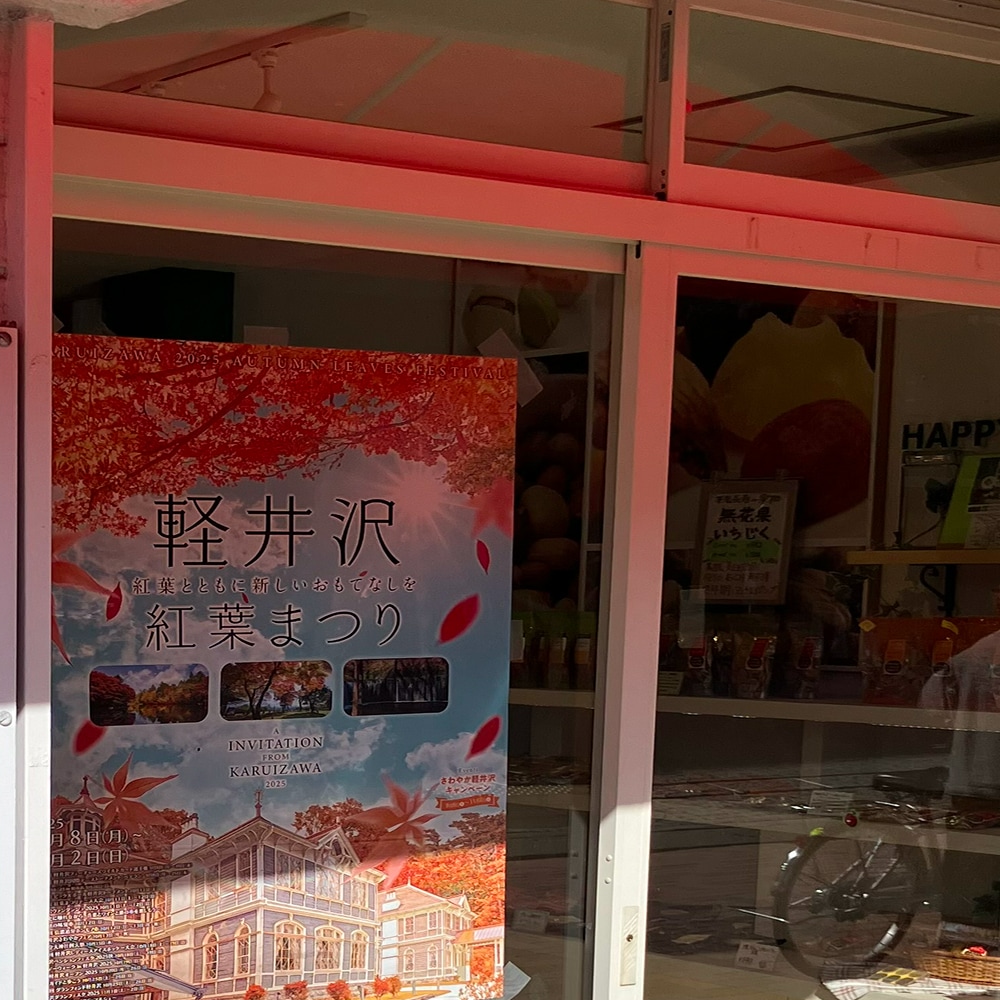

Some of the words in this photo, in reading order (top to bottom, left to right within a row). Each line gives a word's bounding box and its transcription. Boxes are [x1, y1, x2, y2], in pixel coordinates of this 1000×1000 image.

[175, 352, 220, 366] 2025
[233, 357, 321, 371] AUTUMN
[333, 360, 405, 375] LEAVES
[416, 364, 506, 380] FESTIVAL
[902, 418, 1000, 450] HAPP
[153, 494, 401, 569] 軽井沢
[713, 526, 770, 541] いちじく
[132, 575, 418, 595] 紅葉とともに新しいおもてなしを
[145, 602, 403, 652] 紅葉まつり
[228, 737, 324, 751] INVITATION
[262, 753, 290, 762] FROM
[229, 763, 322, 778] KARUIZAWA
[265, 780, 287, 789] 2025
[440, 774, 496, 785] さわやか軽井沢
[445, 785, 491, 795] キャンペーン
